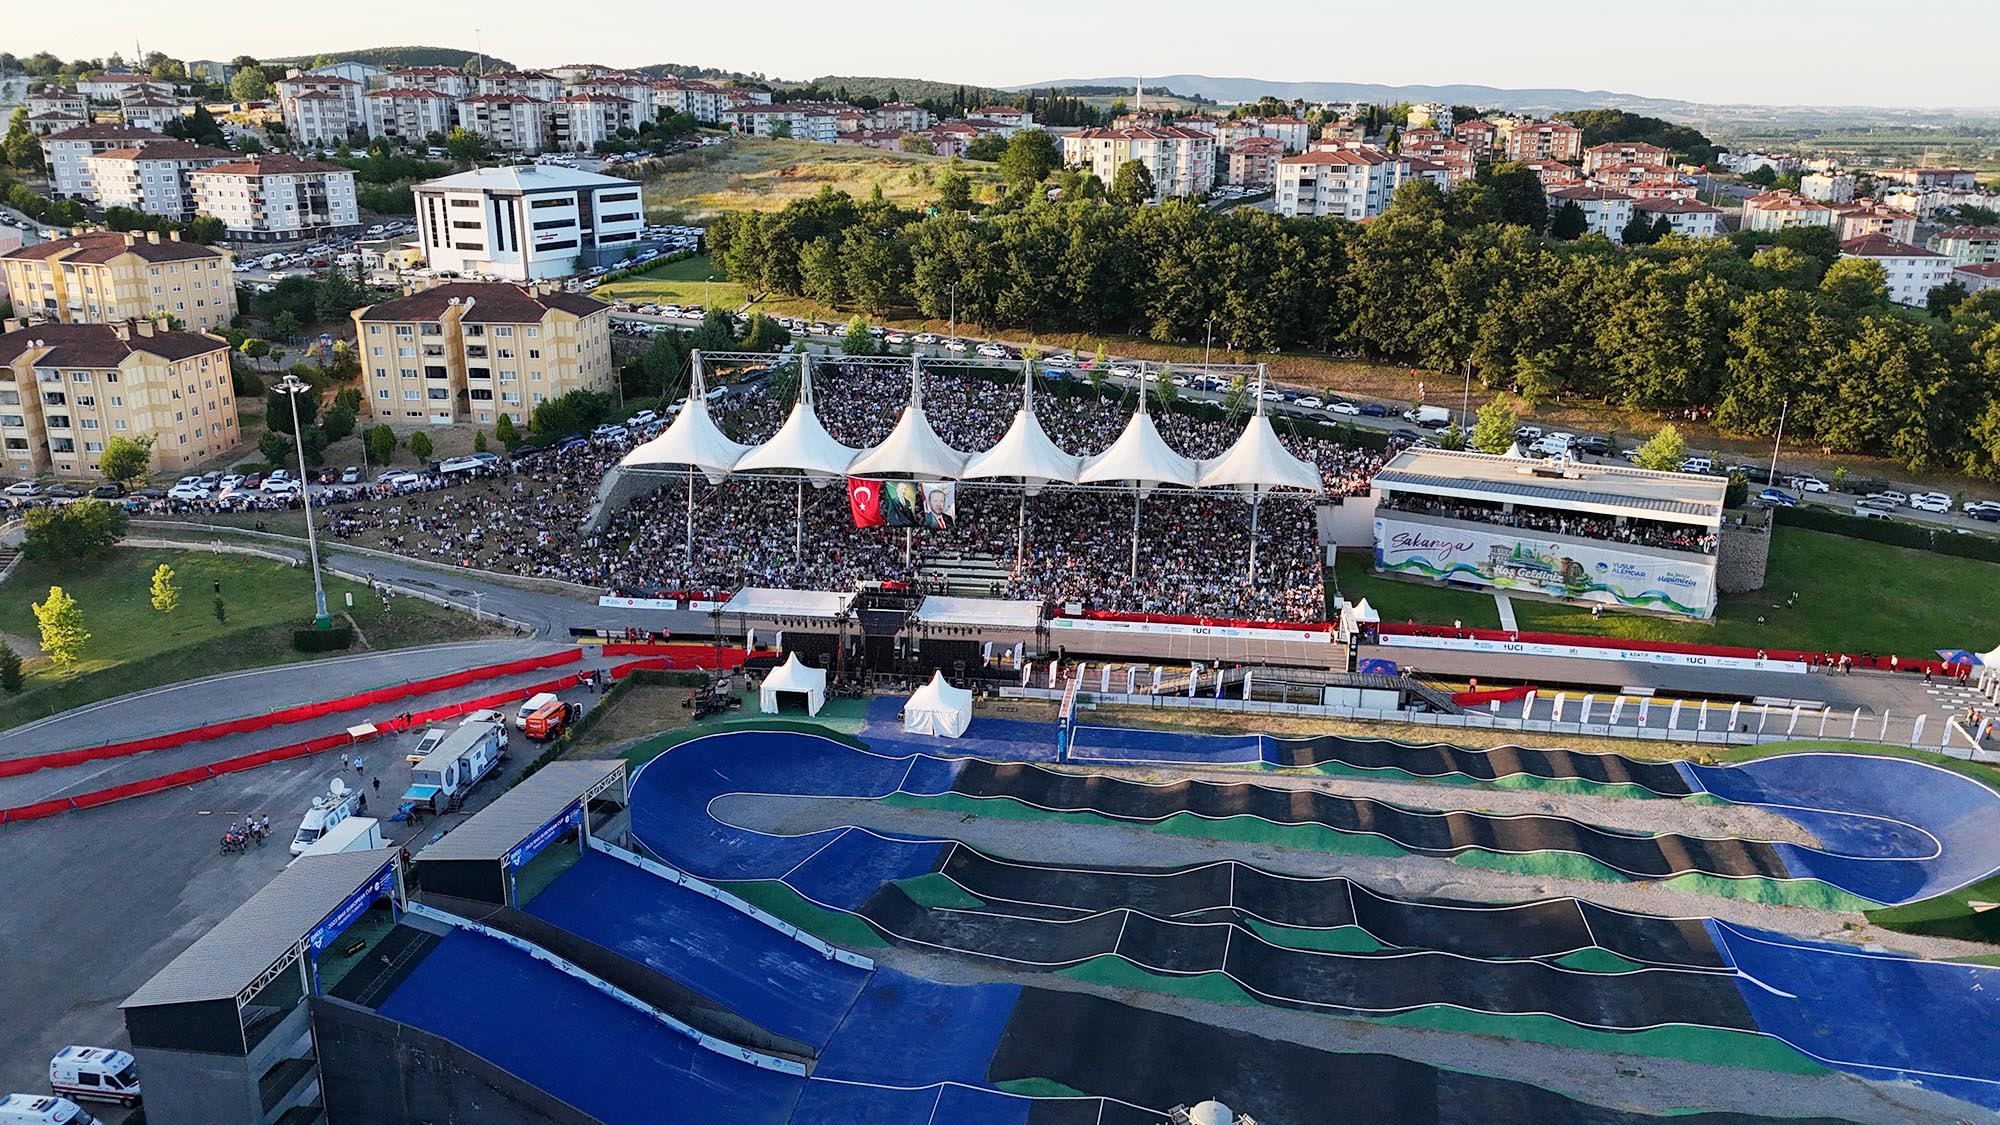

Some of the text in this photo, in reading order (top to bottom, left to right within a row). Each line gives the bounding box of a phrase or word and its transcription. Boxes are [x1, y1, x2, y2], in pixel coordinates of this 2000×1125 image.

[1391, 532, 1474, 561] Sakarya
[1611, 567, 1646, 577] ALEMDAR
[1612, 562, 1636, 570] YUSUF
[1493, 564, 1564, 583] Hoş Geldiniz
[1657, 575, 1697, 587] Hepimizin
[1689, 657, 1707, 665] UCI
[337, 912, 346, 921] BMX
[346, 894, 366, 914] EUROPEAN
[365, 885, 374, 896] CUP
